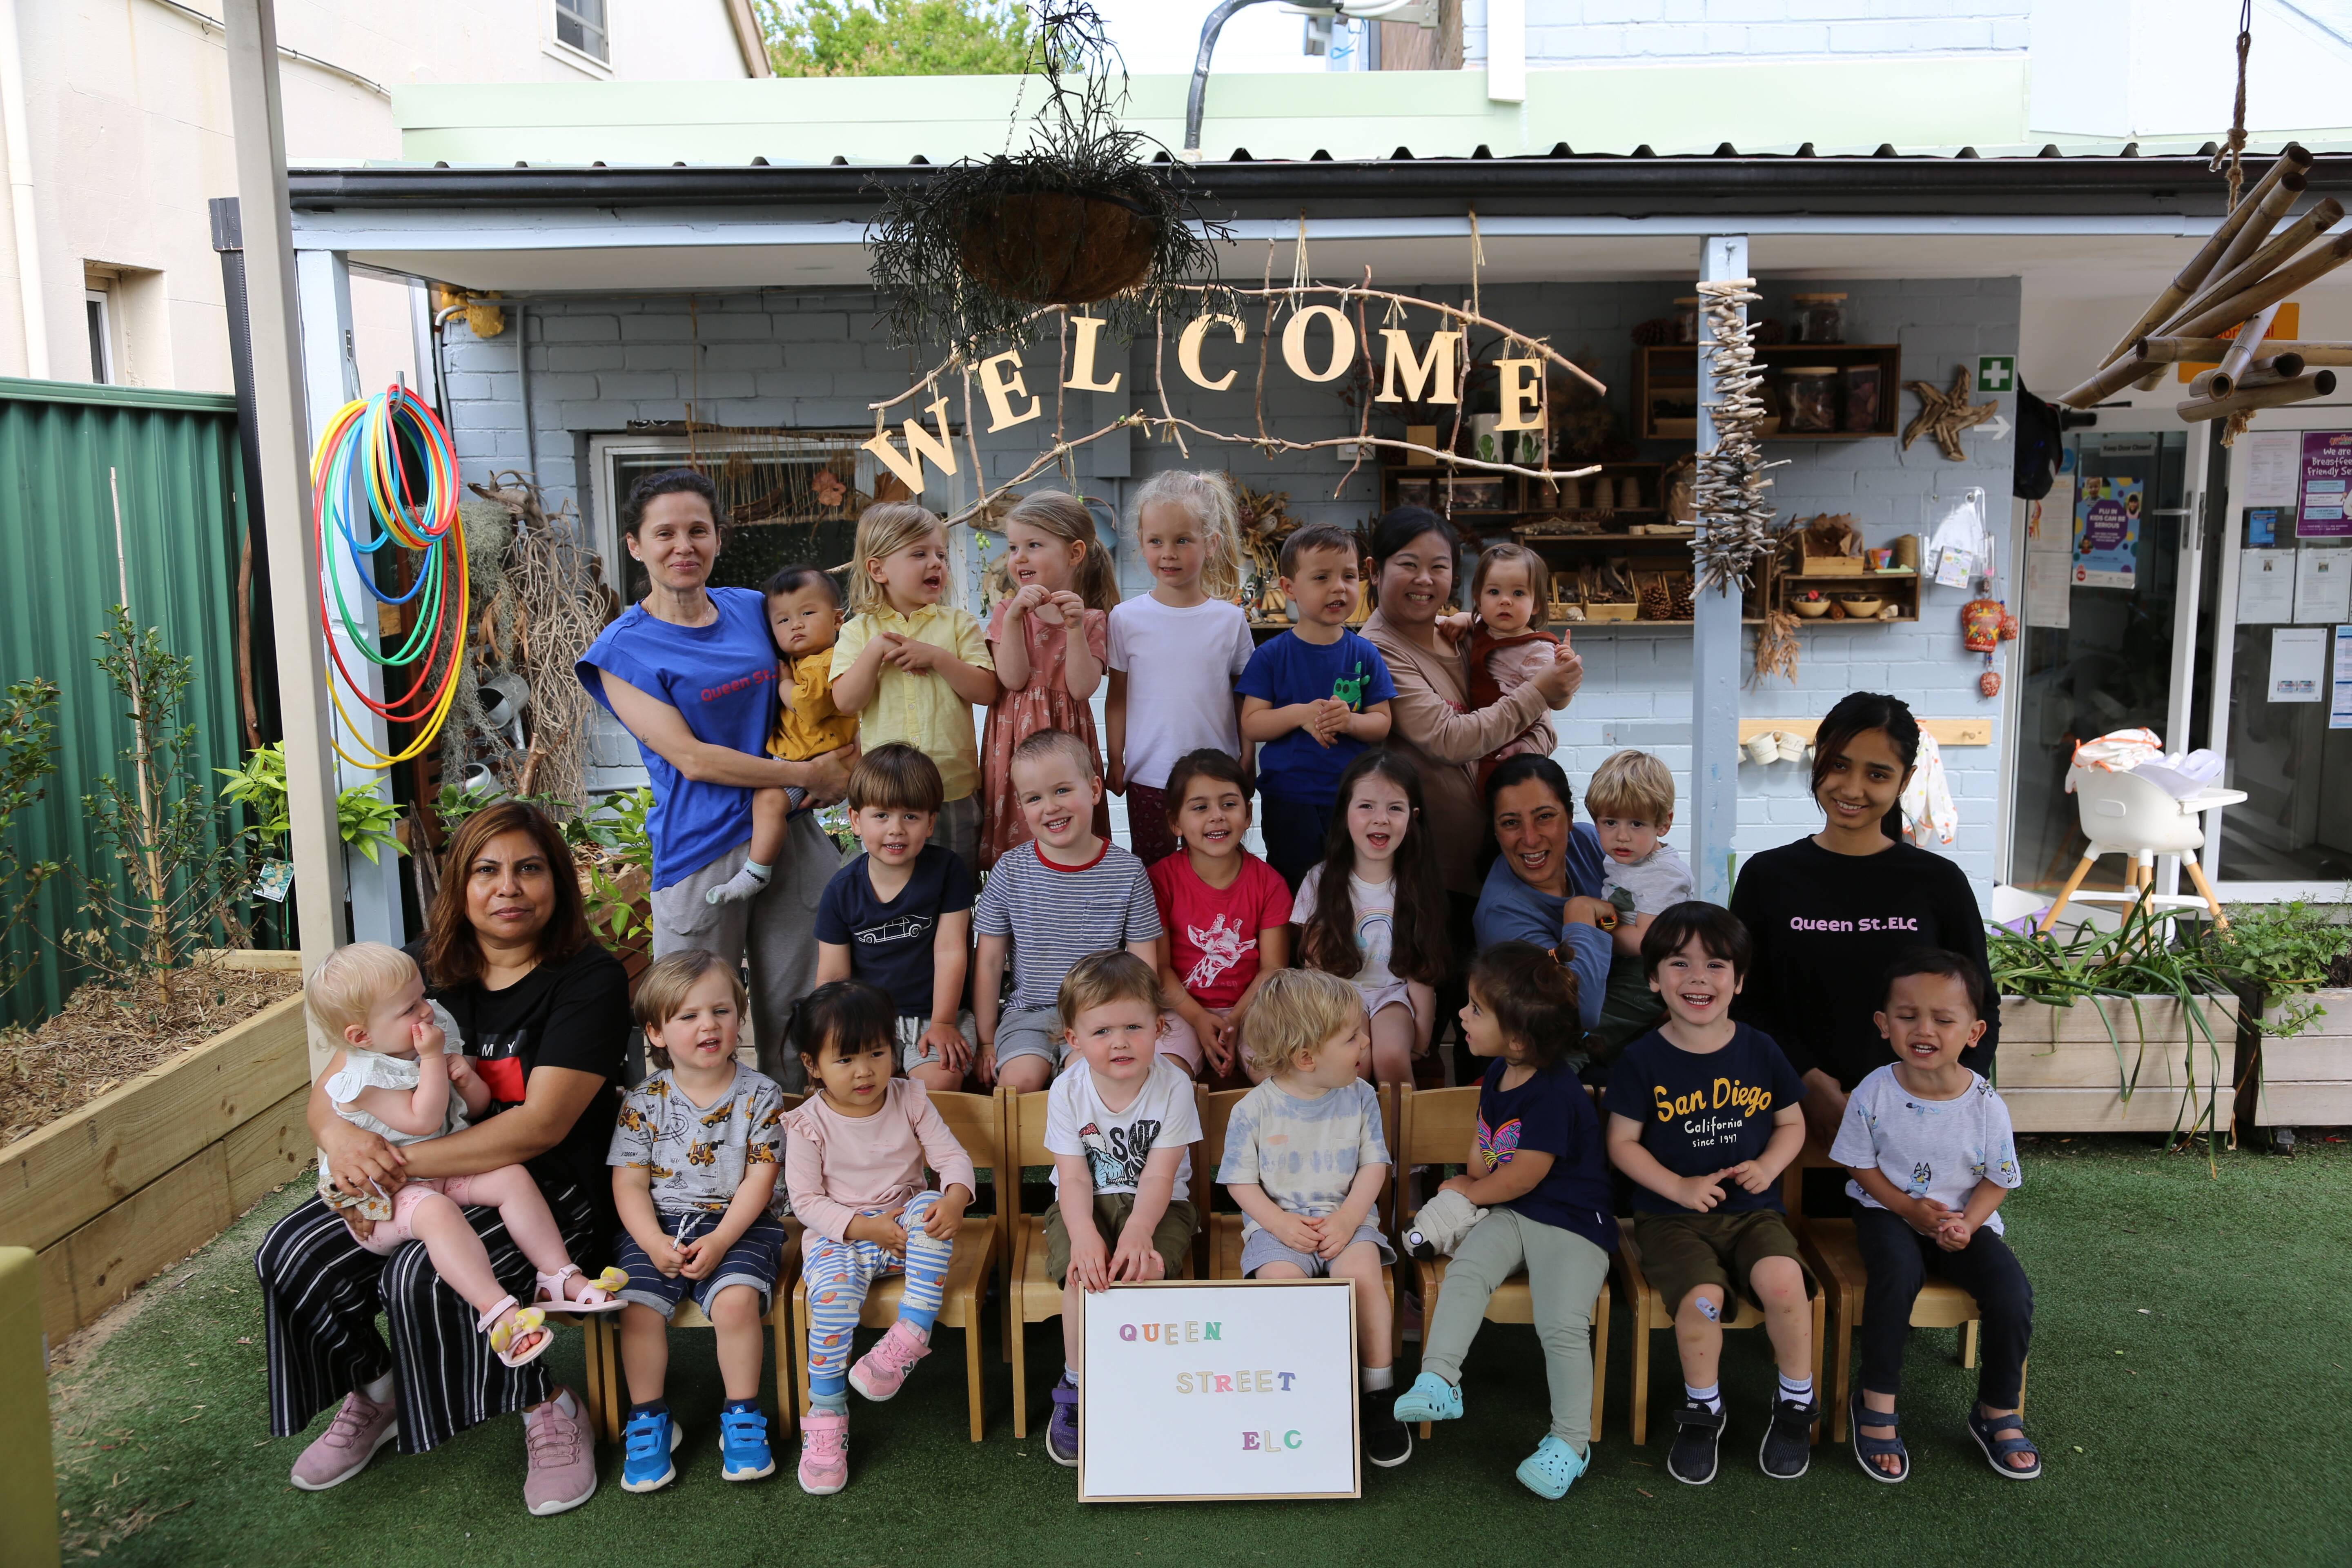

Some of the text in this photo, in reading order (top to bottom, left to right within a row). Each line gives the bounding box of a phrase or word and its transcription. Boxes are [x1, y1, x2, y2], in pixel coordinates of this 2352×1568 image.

[861, 305, 1544, 495] WELCOME
[2307, 466, 2352, 477] Friendly Se
[701, 677, 751, 702] Queen
[1790, 917, 1853, 931] Queen
[1654, 1078, 1772, 1122] San Diego
[1684, 1116, 1743, 1136] California
[1693, 1134, 1737, 1148] since 1947
[1119, 1321, 1222, 1345] QUEEN
[1176, 1370, 1295, 1393] STREET
[1242, 1430, 1302, 1452] ELC
